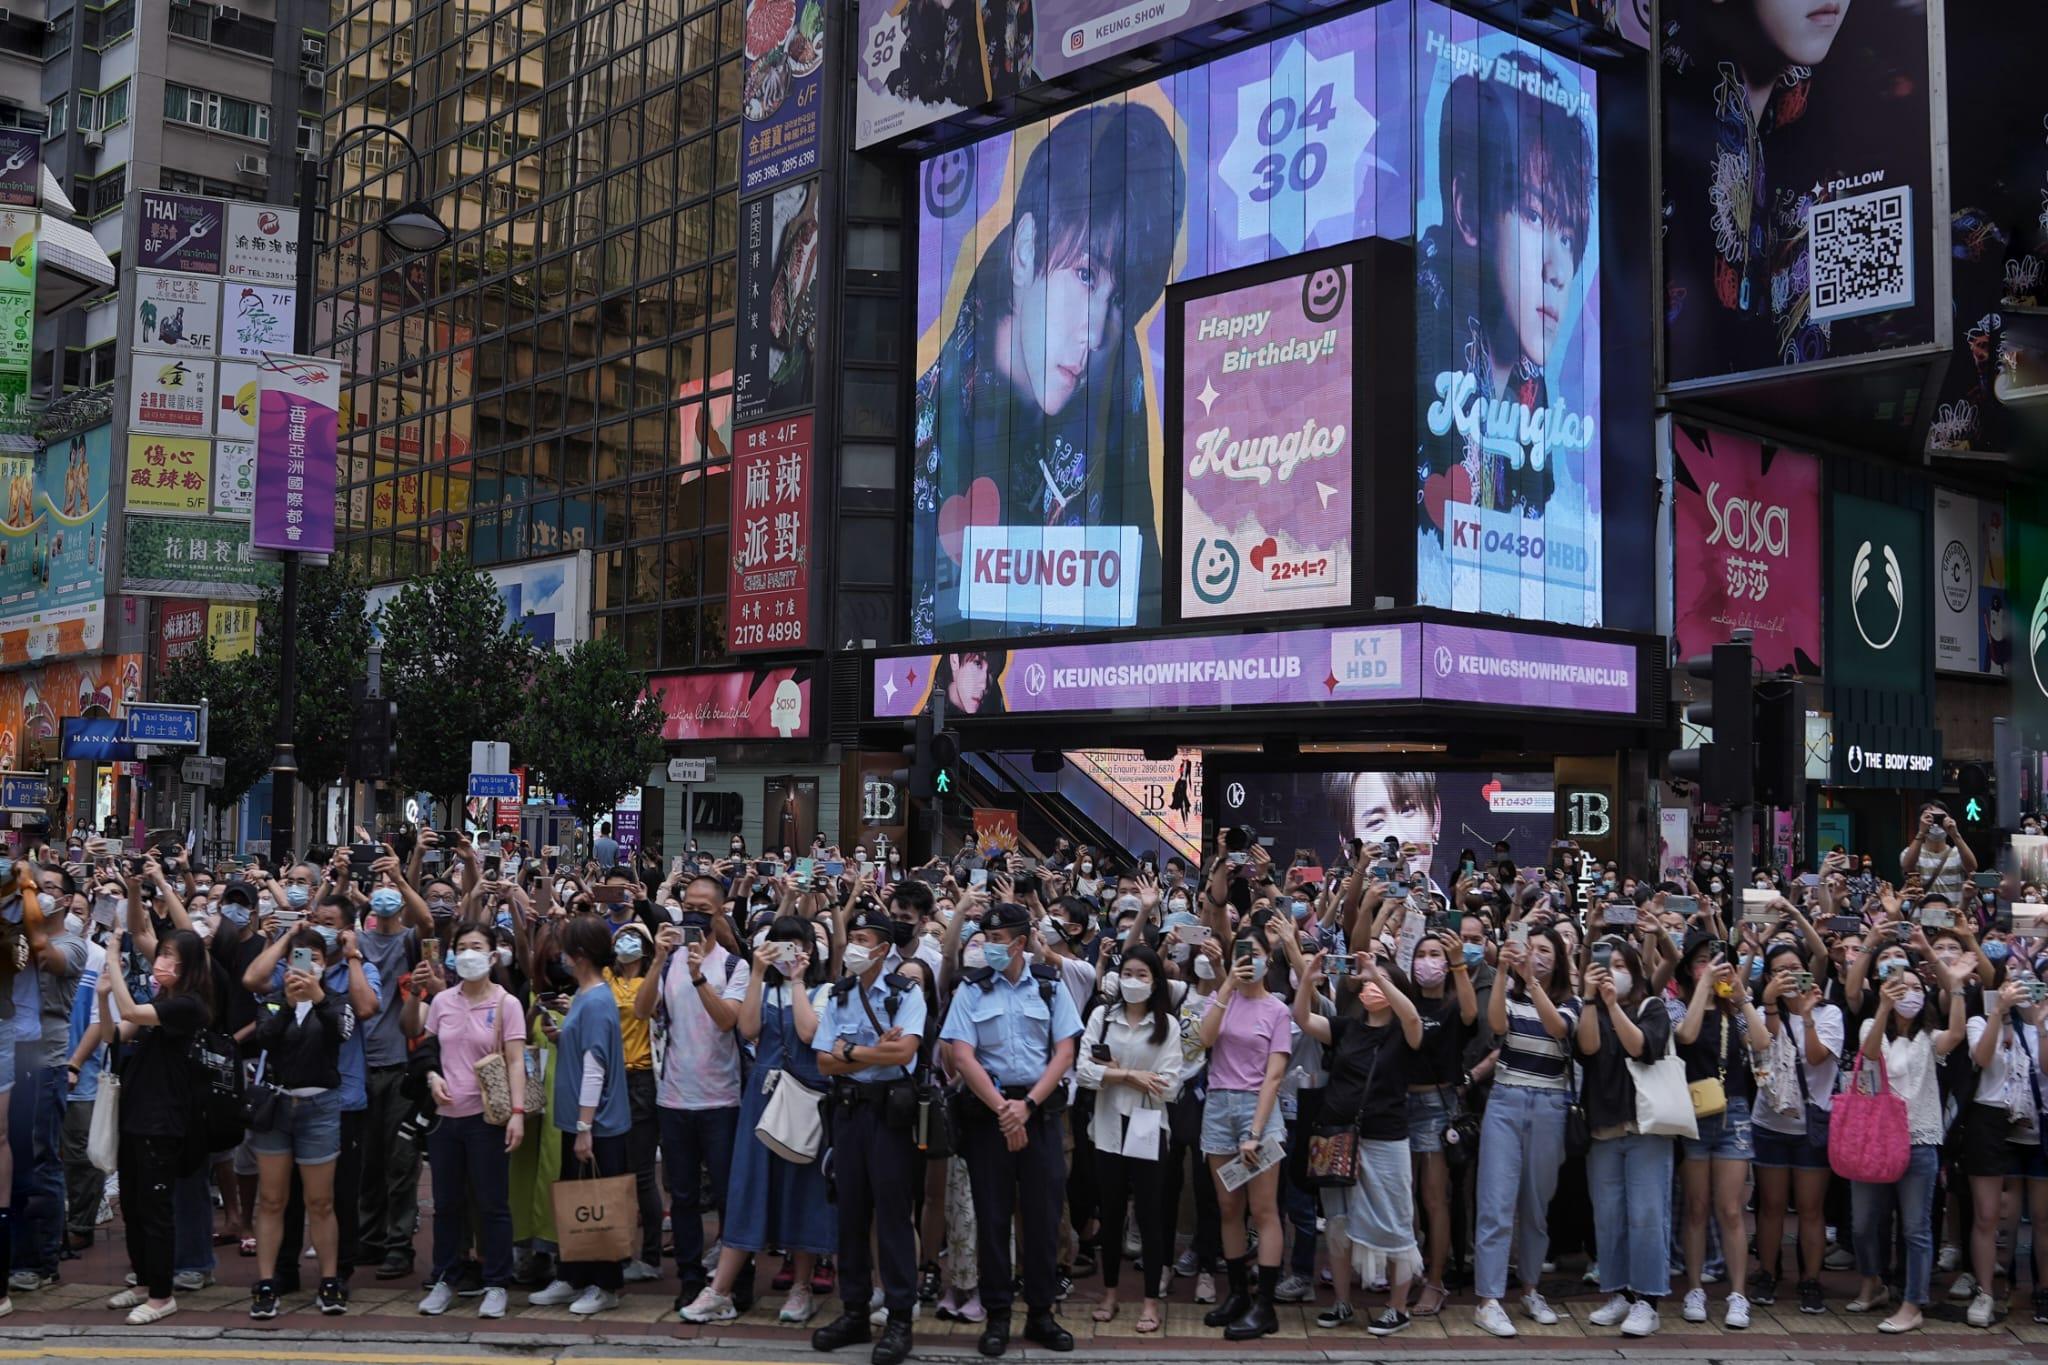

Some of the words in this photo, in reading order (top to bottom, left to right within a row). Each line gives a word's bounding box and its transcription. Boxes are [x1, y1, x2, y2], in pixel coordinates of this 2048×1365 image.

[1095, 16, 1131, 40] KEUNG
[1133, 3, 1166, 26] SHOW
[874, 25, 896, 48] 04
[871, 45, 893, 67] 30
[1425, 30, 1495, 82] Happy
[1495, 58, 1591, 118] Birthday!!
[797, 83, 817, 107] 6/F
[1257, 82, 1337, 147] 04
[747, 169, 762, 187] 2895
[781, 156, 798, 174] 2895
[798, 149, 815, 168] 6398
[1248, 142, 1328, 202] 30
[1827, 169, 1885, 193] FOLLOW
[145, 198, 177, 221] THAI
[144, 239, 162, 252] 8/F
[228, 264, 246, 275] 8/F
[248, 269, 264, 278] TEL:
[156, 277, 200, 294] 新巴黎
[272, 294, 292, 305] 7/F
[1197, 309, 1271, 341] Happy
[189, 334, 211, 347] 5/F
[1222, 330, 1338, 374] Birthday!!
[737, 373, 751, 391] 3F
[1427, 370, 1595, 472] Keungto
[748, 430, 767, 447] 四樓
[777, 424, 797, 443] 4/F
[144, 444, 195, 467] 傷心
[1188, 418, 1346, 486] Keungto
[131, 468, 206, 490] 酸辣粉
[285, 405, 307, 541] 香港亞洲國際都會
[745, 452, 802, 511] 麻辣
[186, 497, 205, 508] 5/F
[743, 511, 800, 568] 派對
[767, 569, 797, 589] PARTY
[974, 548, 1120, 588] KEUNGTO
[1271, 558, 1328, 580] 22+1=?
[1726, 555, 1769, 602] 莎莎
[735, 623, 764, 645] 2178
[767, 620, 801, 642] 4898
[1354, 636, 1381, 657] KT
[1052, 656, 1301, 690] KEUNGSHOWHKFANCLUB
[1346, 660, 1388, 680] HBD
[1458, 655, 1629, 688] KEUNGSHOWHKFANCLUB
[694, 703, 711, 727] life
[712, 701, 751, 728] beautiful
[776, 696, 796, 710] Sasa
[142, 713, 158, 721] Taxi
[159, 713, 182, 722] Stand
[145, 725, 178, 736] 的士站
[675, 760, 684, 768] East
[694, 760, 705, 768] Road
[1113, 765, 1137, 774] Enquiry
[1142, 765, 1158, 773] 2890
[1158, 765, 1175, 773] 6870
[1865, 752, 1881, 769] THE
[1885, 753, 1909, 771] BODY
[1910, 755, 1933, 772] SHOP
[16, 781, 33, 790] Taxi
[1143, 784, 1165, 811] iB
[1493, 798, 1505, 807] KT
[1507, 797, 1533, 807] 0430
[1568, 792, 1610, 836] iB
[576, 1206, 605, 1223] GU
